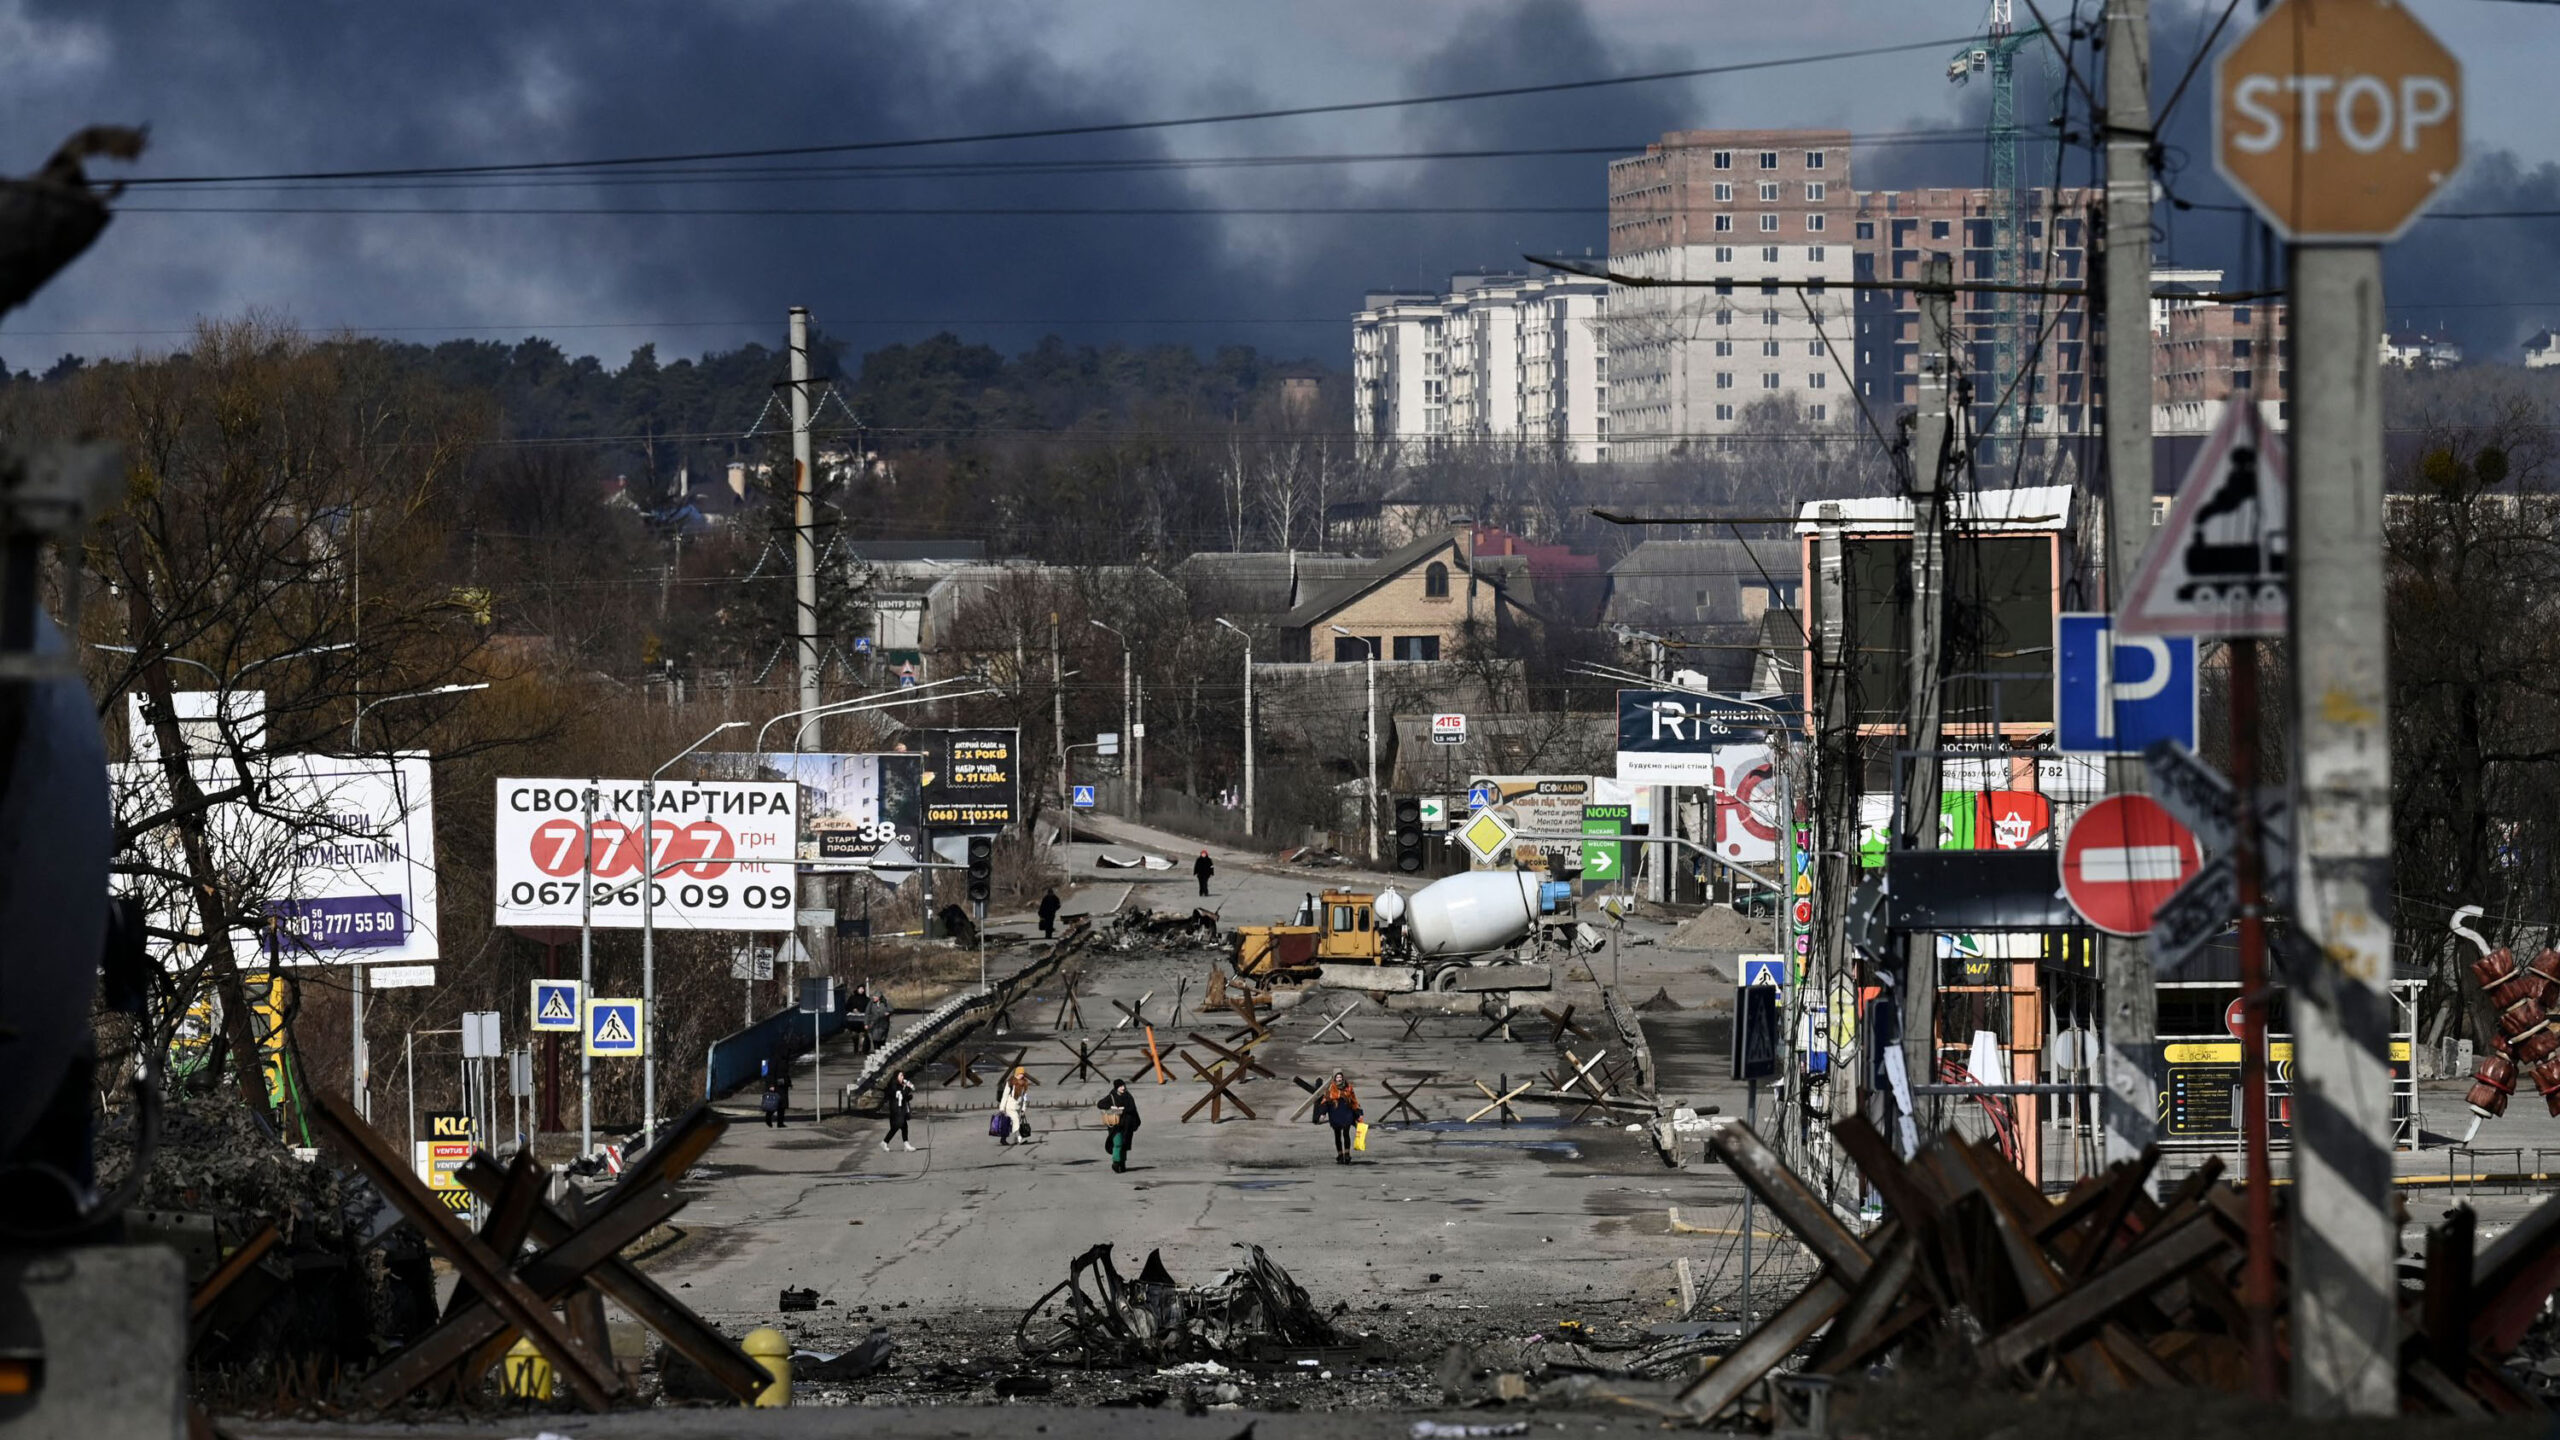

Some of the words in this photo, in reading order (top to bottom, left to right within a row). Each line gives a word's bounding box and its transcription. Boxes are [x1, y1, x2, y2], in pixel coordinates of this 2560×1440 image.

[2234, 74, 2453, 152] STOP
[2096, 629, 2171, 738] P
[1710, 724, 1731, 734] CO.
[975, 749, 1007, 759] РОКІВ
[955, 764, 975, 772] НАБІР
[977, 764, 996, 772] УЧНІВ
[2049, 767, 2063, 776] 82
[980, 772, 1006, 782] КЛАС
[1540, 784, 1584, 792] ECOKAMIN
[510, 788, 600, 812] СВОЯ
[614, 789, 791, 816] КВАРТИРА
[928, 809, 957, 821] (068)
[1586, 808, 1628, 818] NOVUS
[740, 832, 775, 848] грн
[740, 856, 771, 873] міс
[511, 882, 581, 905] 067
[592, 883, 666, 907] 960
[680, 884, 729, 907] 09
[743, 886, 791, 909] 09
[311, 909, 322, 918] 50
[312, 920, 323, 929] 73
[325, 914, 352, 934] 777
[355, 914, 374, 932] 55
[377, 911, 394, 930] 50
[313, 931, 323, 941] 98
